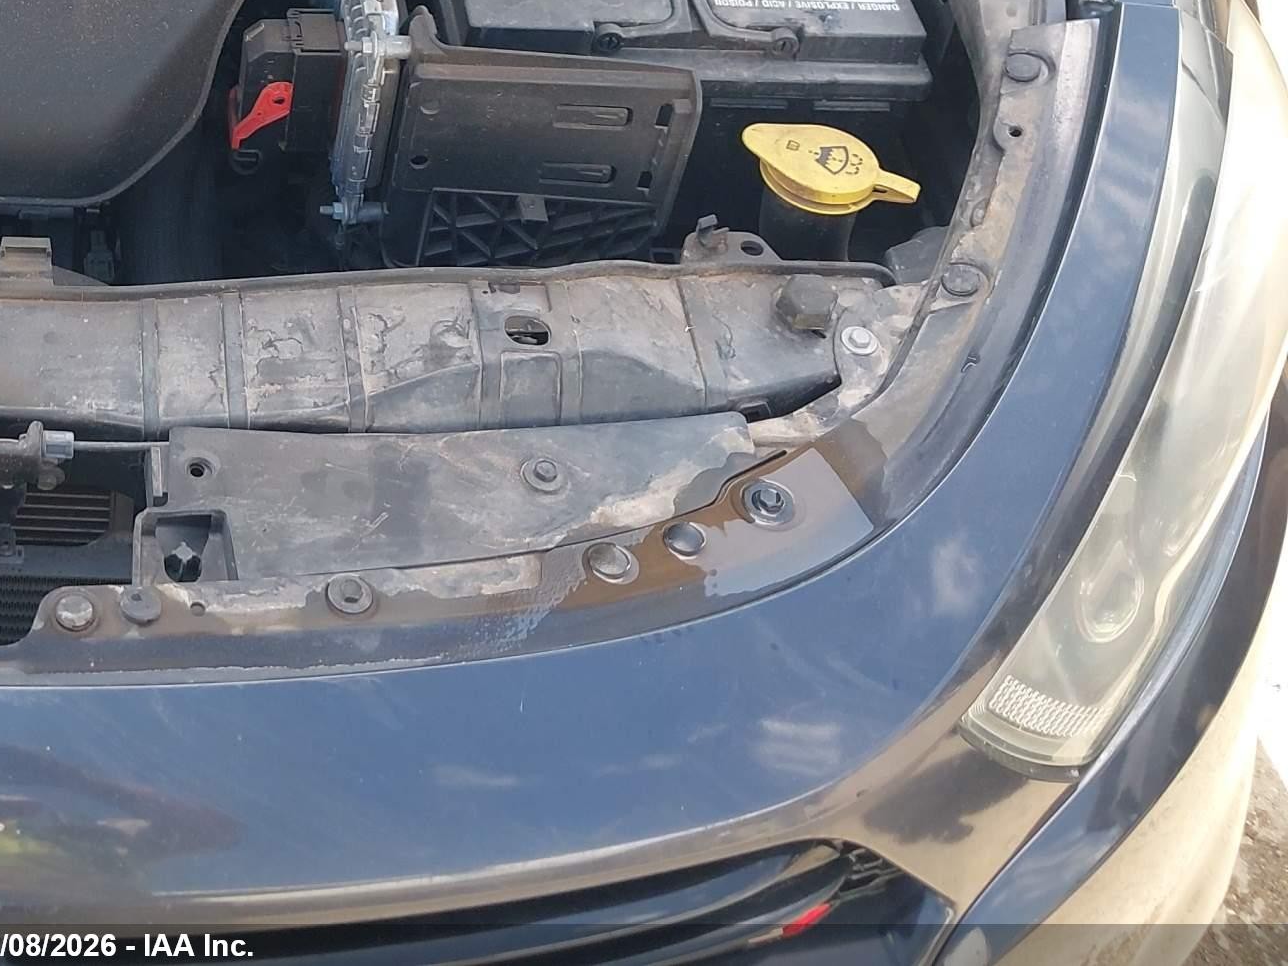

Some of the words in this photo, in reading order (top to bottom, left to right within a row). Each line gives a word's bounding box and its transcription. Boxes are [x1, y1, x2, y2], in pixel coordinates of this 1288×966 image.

[715, 0, 754, 8] POISON
[761, 0, 785, 9] ACID
[795, 0, 850, 10] EXPLOSIVE
[858, 1, 900, 11] DANGER
